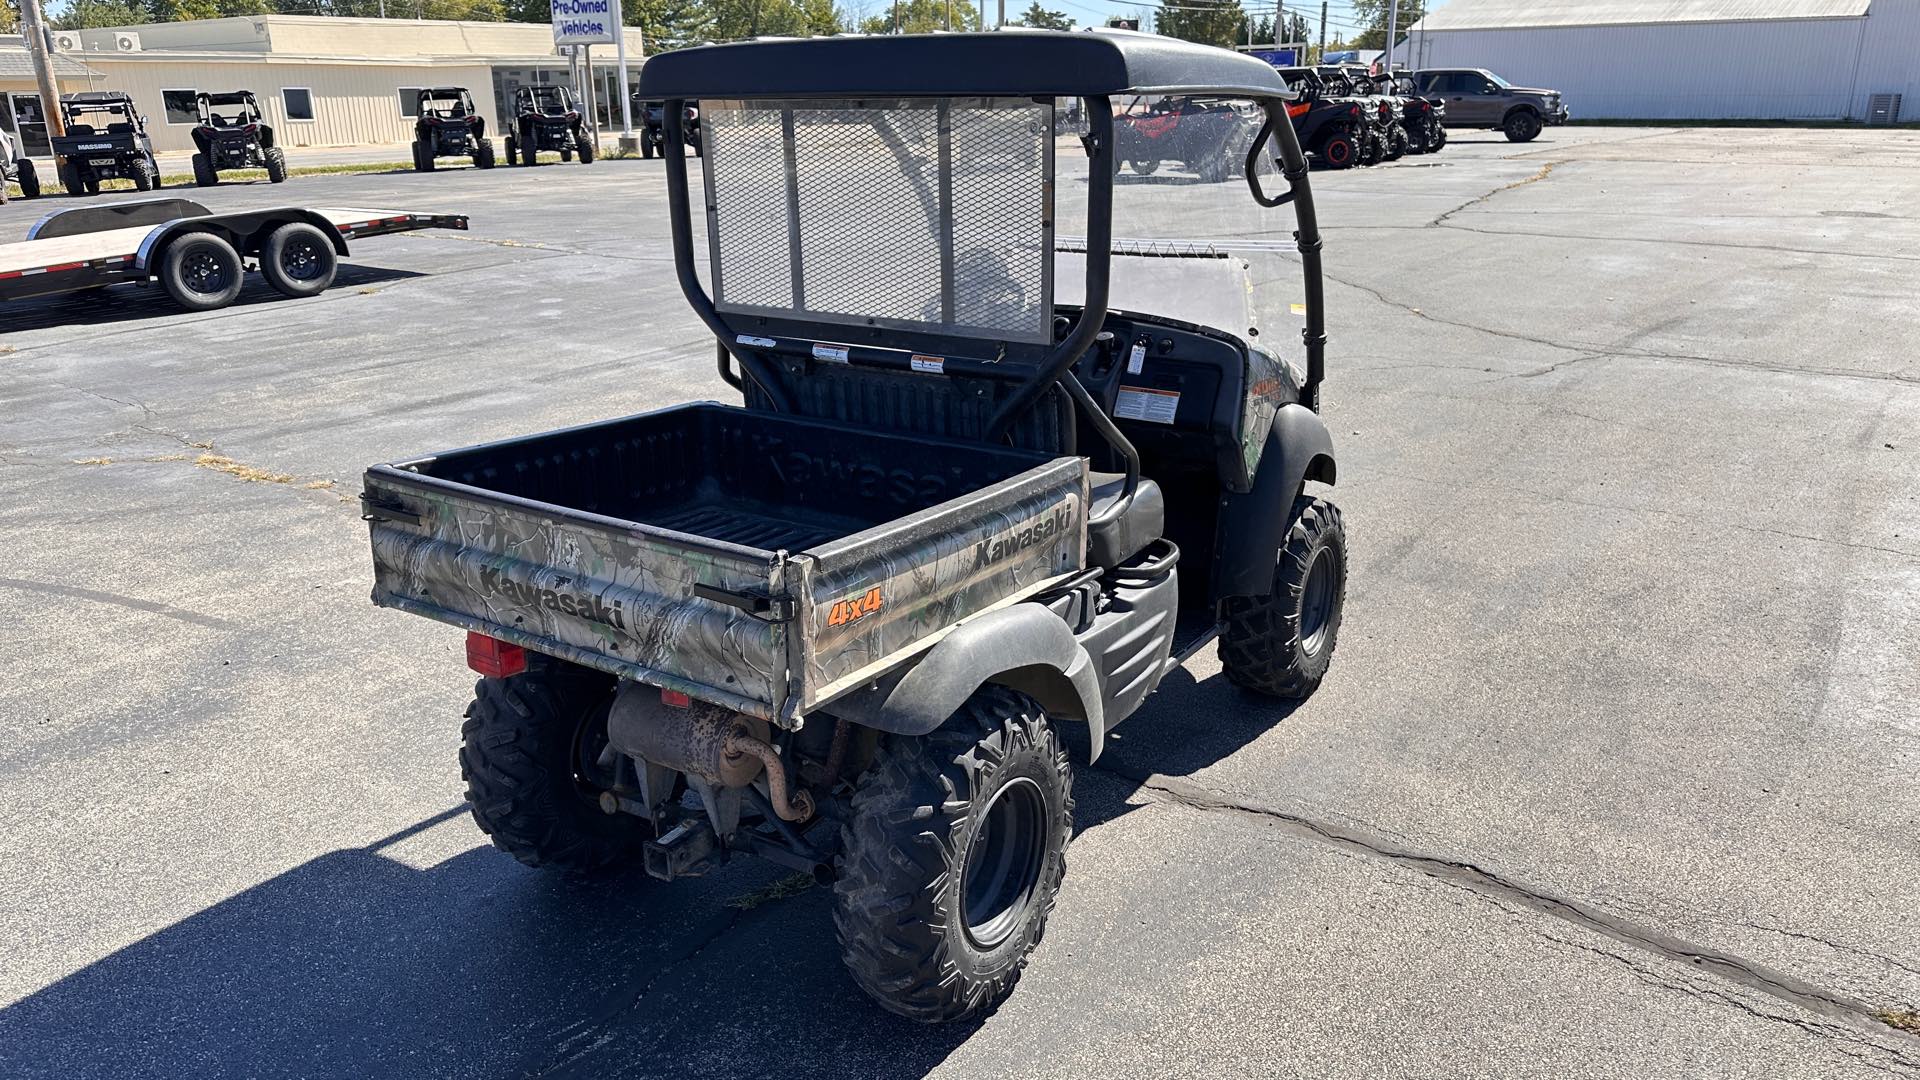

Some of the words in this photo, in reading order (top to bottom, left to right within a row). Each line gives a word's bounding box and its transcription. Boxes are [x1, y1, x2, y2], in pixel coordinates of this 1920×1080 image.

[552, 0, 608, 15] Pre-Owned
[561, 20, 603, 35] Vehicles
[972, 504, 1073, 569] Kawasaki
[479, 565, 626, 630] Kawasaki
[827, 587, 884, 628] 4x4
